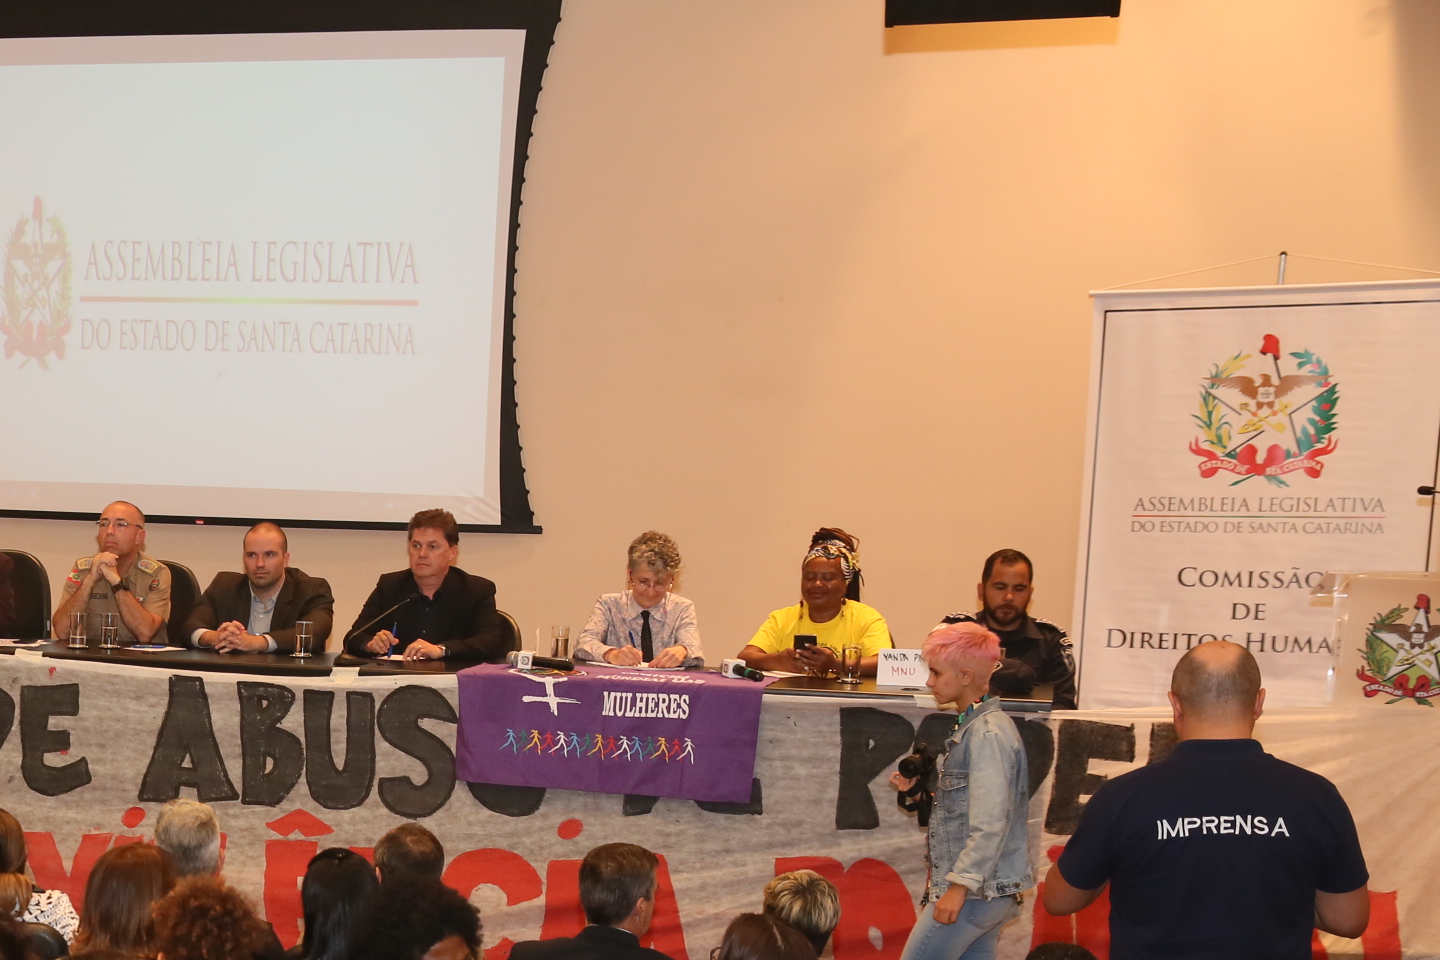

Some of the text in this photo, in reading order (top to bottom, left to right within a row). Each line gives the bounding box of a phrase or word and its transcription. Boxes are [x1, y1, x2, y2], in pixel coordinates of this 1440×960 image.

[83, 239, 419, 284] ASSEMBLEIA LEGISLATIVA
[80, 318, 417, 355] DO ESTADO DE SANTA CATARINA
[1133, 496, 1386, 513] ASSEMBLEIA LEGISLATIVA
[1130, 520, 1385, 535] DO ESTADO DE SANTA CATARINA
[1230, 602, 1267, 621] DE
[891, 666, 916, 676] MNU
[601, 691, 690, 719] MULHERES
[138, 675, 546, 818] ABUS
[1156, 814, 1290, 840] IMPRENSA
